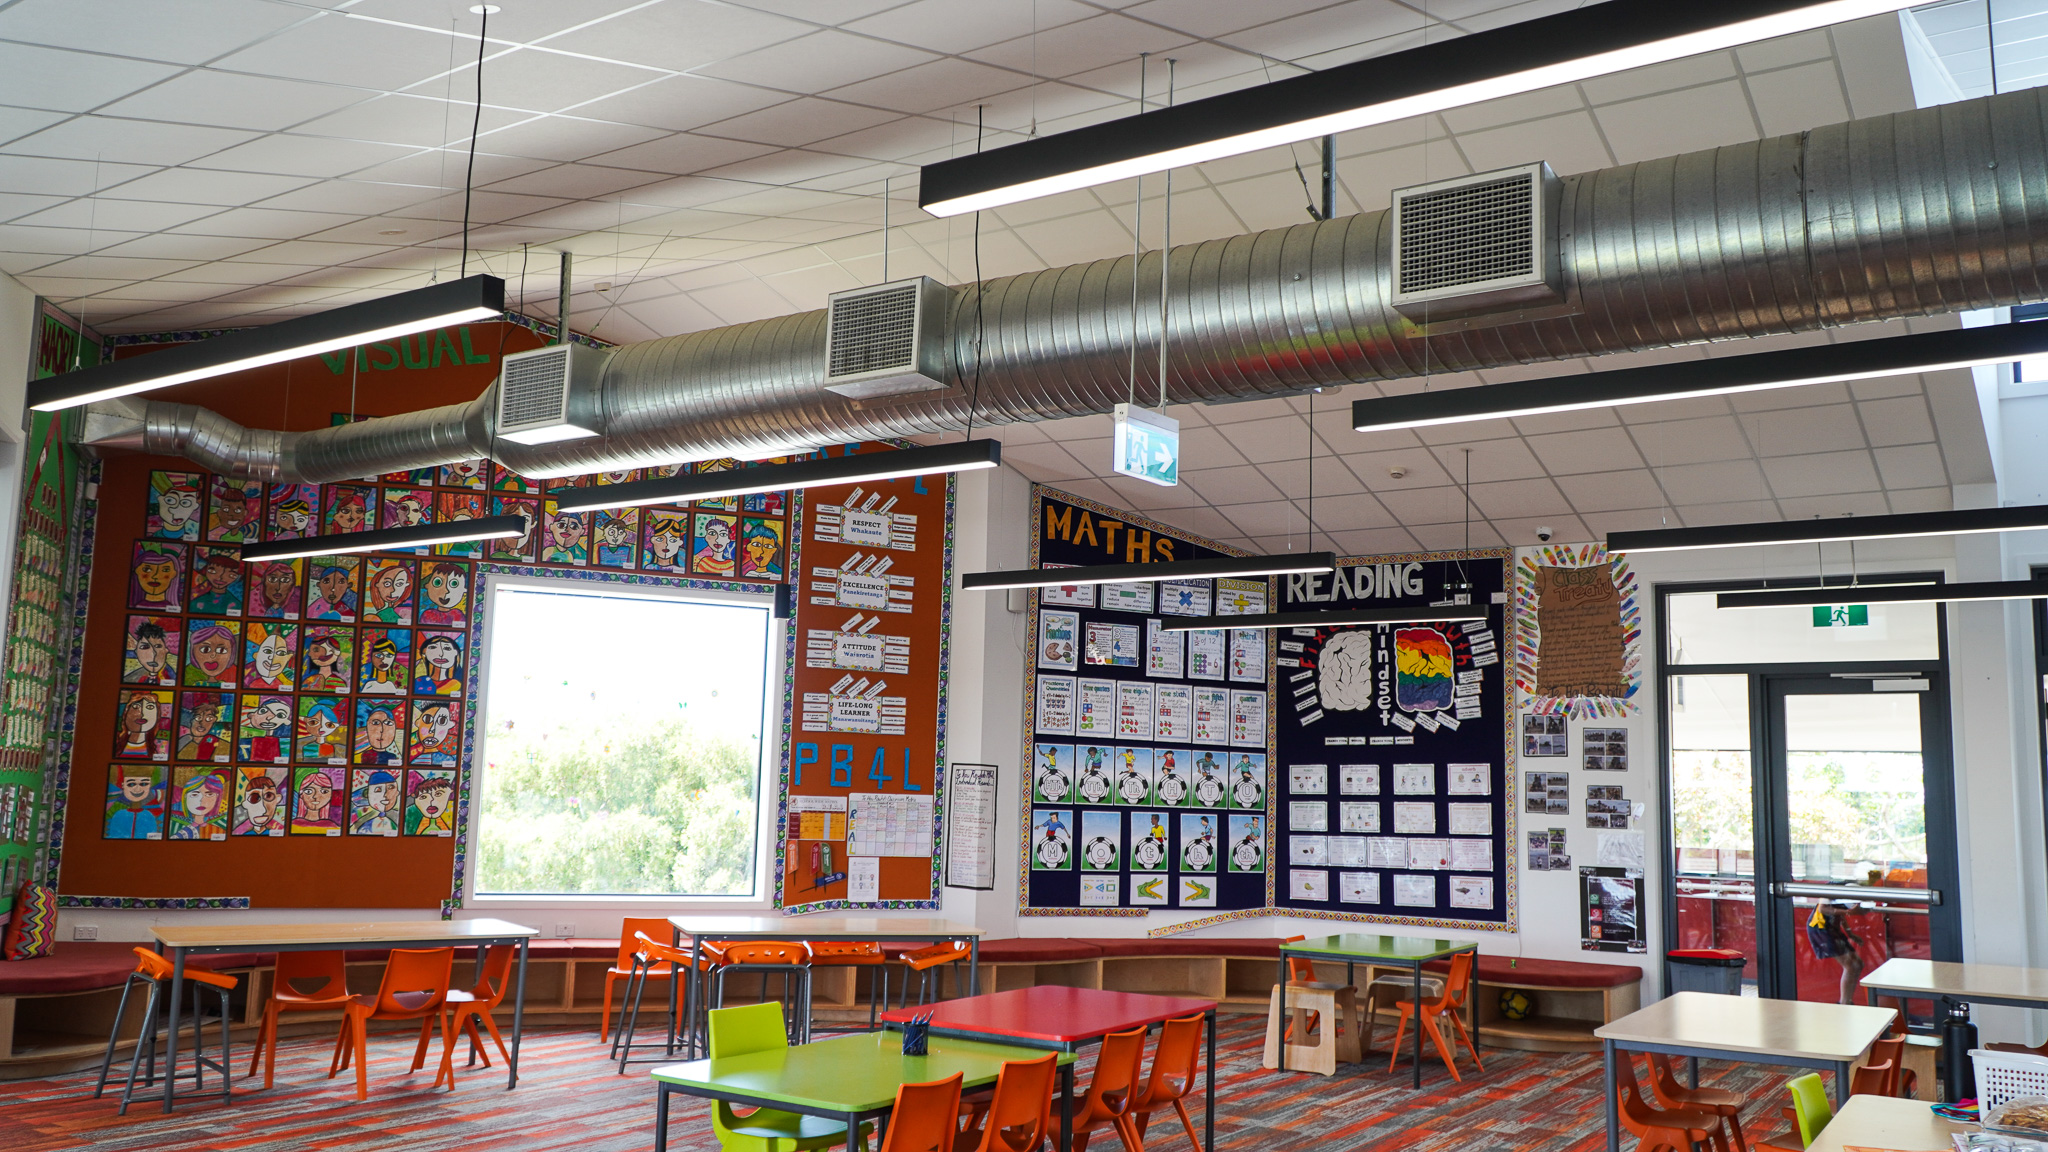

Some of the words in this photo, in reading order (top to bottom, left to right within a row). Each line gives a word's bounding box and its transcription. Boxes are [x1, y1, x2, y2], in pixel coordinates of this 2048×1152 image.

[320, 326, 490, 375] VISUAL
[852, 519, 881, 528] RESPECT
[1047, 505, 1174, 563] MATHS
[1287, 562, 1423, 603] READING
[1553, 568, 1598, 587] Class
[843, 581, 884, 591] EXCELLENCE
[1219, 580, 1265, 591] DIVISION
[1554, 577, 1614, 603] Treaty
[1089, 631, 1097, 642] 3
[1209, 637, 1216, 645] 12
[842, 643, 877, 651] ATTITUDE
[1214, 658, 1219, 669] 6
[1128, 781, 1141, 793] Th
[1167, 782, 1178, 795] H
[1204, 784, 1215, 797] T
[1047, 843, 1058, 858] M
[1145, 846, 1154, 859] t
[1193, 848, 1204, 860] h
[1239, 849, 1254, 861] th
